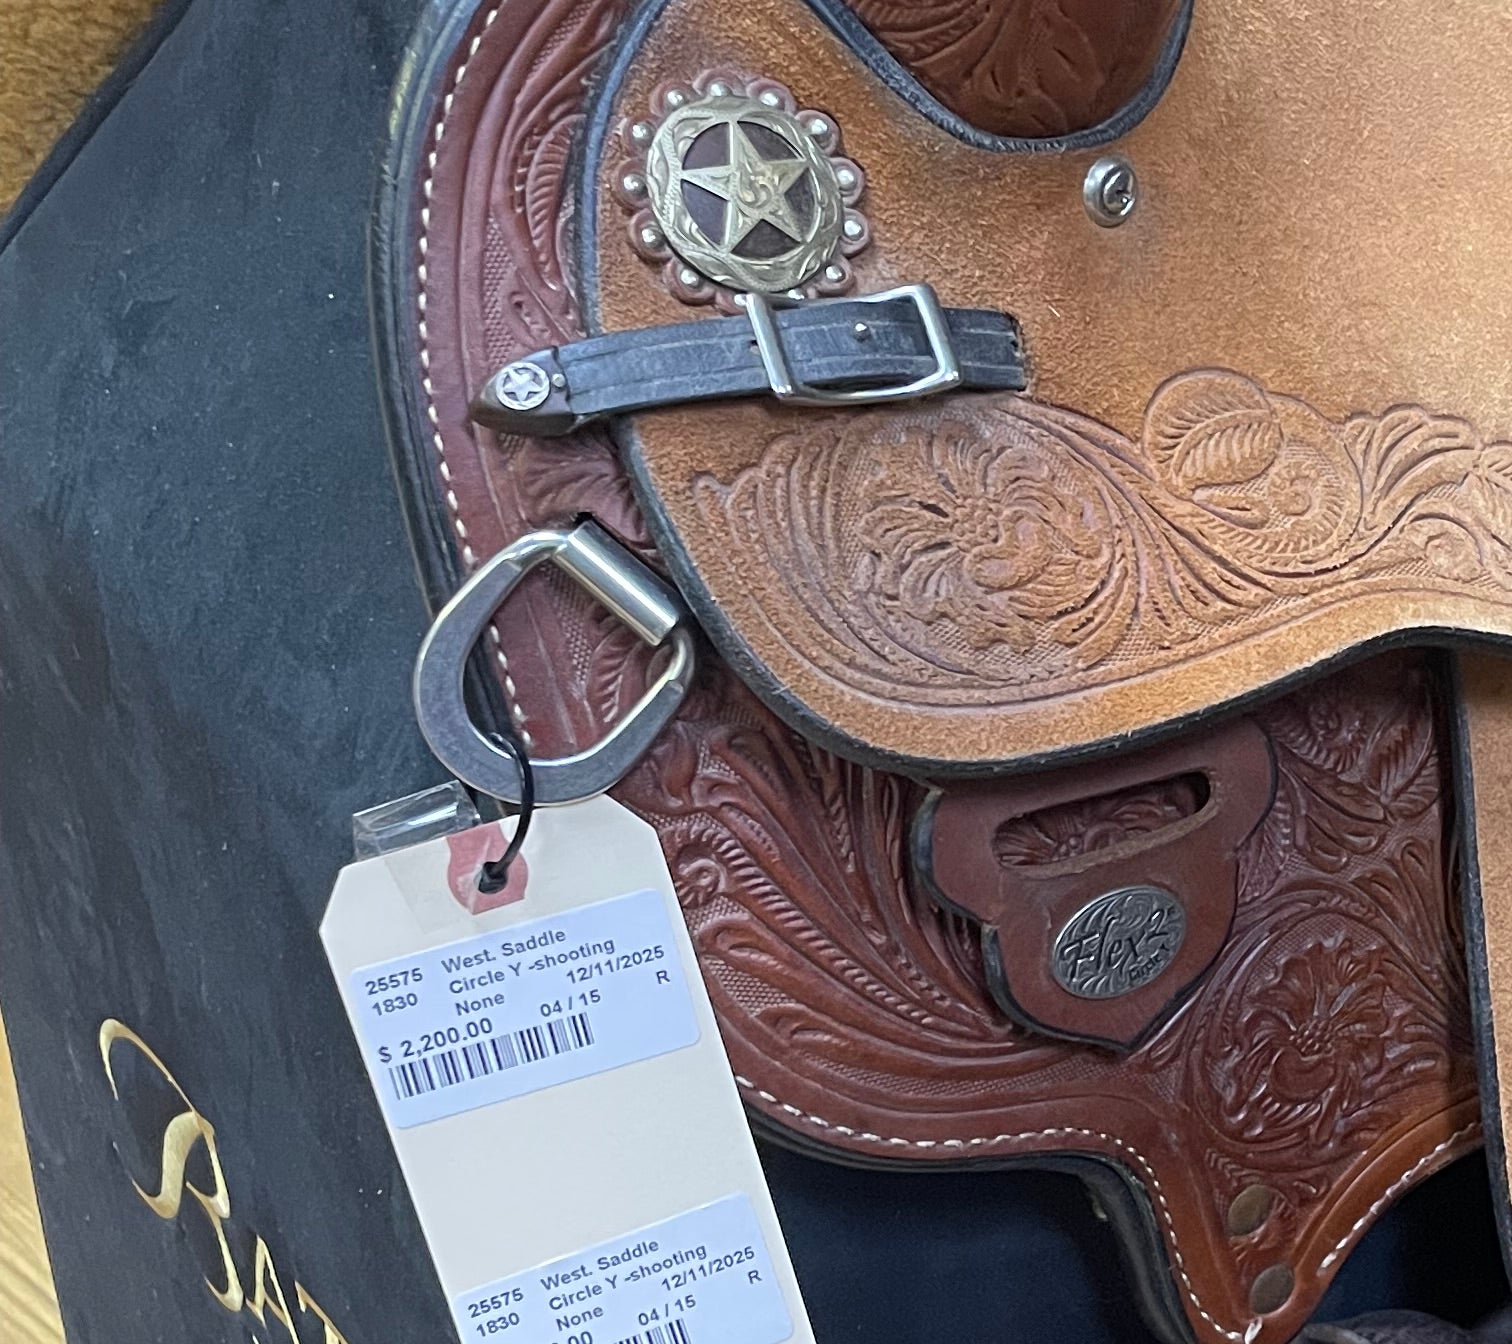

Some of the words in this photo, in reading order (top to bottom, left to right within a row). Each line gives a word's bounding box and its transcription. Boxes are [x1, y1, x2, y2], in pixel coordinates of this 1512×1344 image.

[441, 948, 497, 975] West.
[501, 929, 566, 956] Saddle
[449, 969, 506, 994] Circle
[508, 963, 521, 978] Y
[529, 938, 616, 972] -shooting
[566, 944, 665, 985] 12/11/2025
[366, 967, 423, 995] 25575
[656, 969, 671, 985] R
[371, 992, 418, 1017] 1830
[456, 992, 506, 1017] None
[540, 1000, 563, 1017] 04
[578, 989, 601, 1007] 15
[400, 1017, 492, 1059] 2,200.00
[540, 1263, 593, 1292] West.
[597, 1239, 660, 1271] Saddle
[548, 1283, 603, 1311] Circle
[606, 1275, 619, 1290] Y
[625, 1244, 708, 1285] -shooting
[661, 1246, 755, 1292] 12/11/2025
[748, 1269, 763, 1285] R
[467, 1287, 524, 1319] 25575
[556, 1305, 604, 1331] None
[638, 1309, 660, 1327] 04
[674, 1295, 697, 1312] 15
[475, 1311, 521, 1338] 1830
